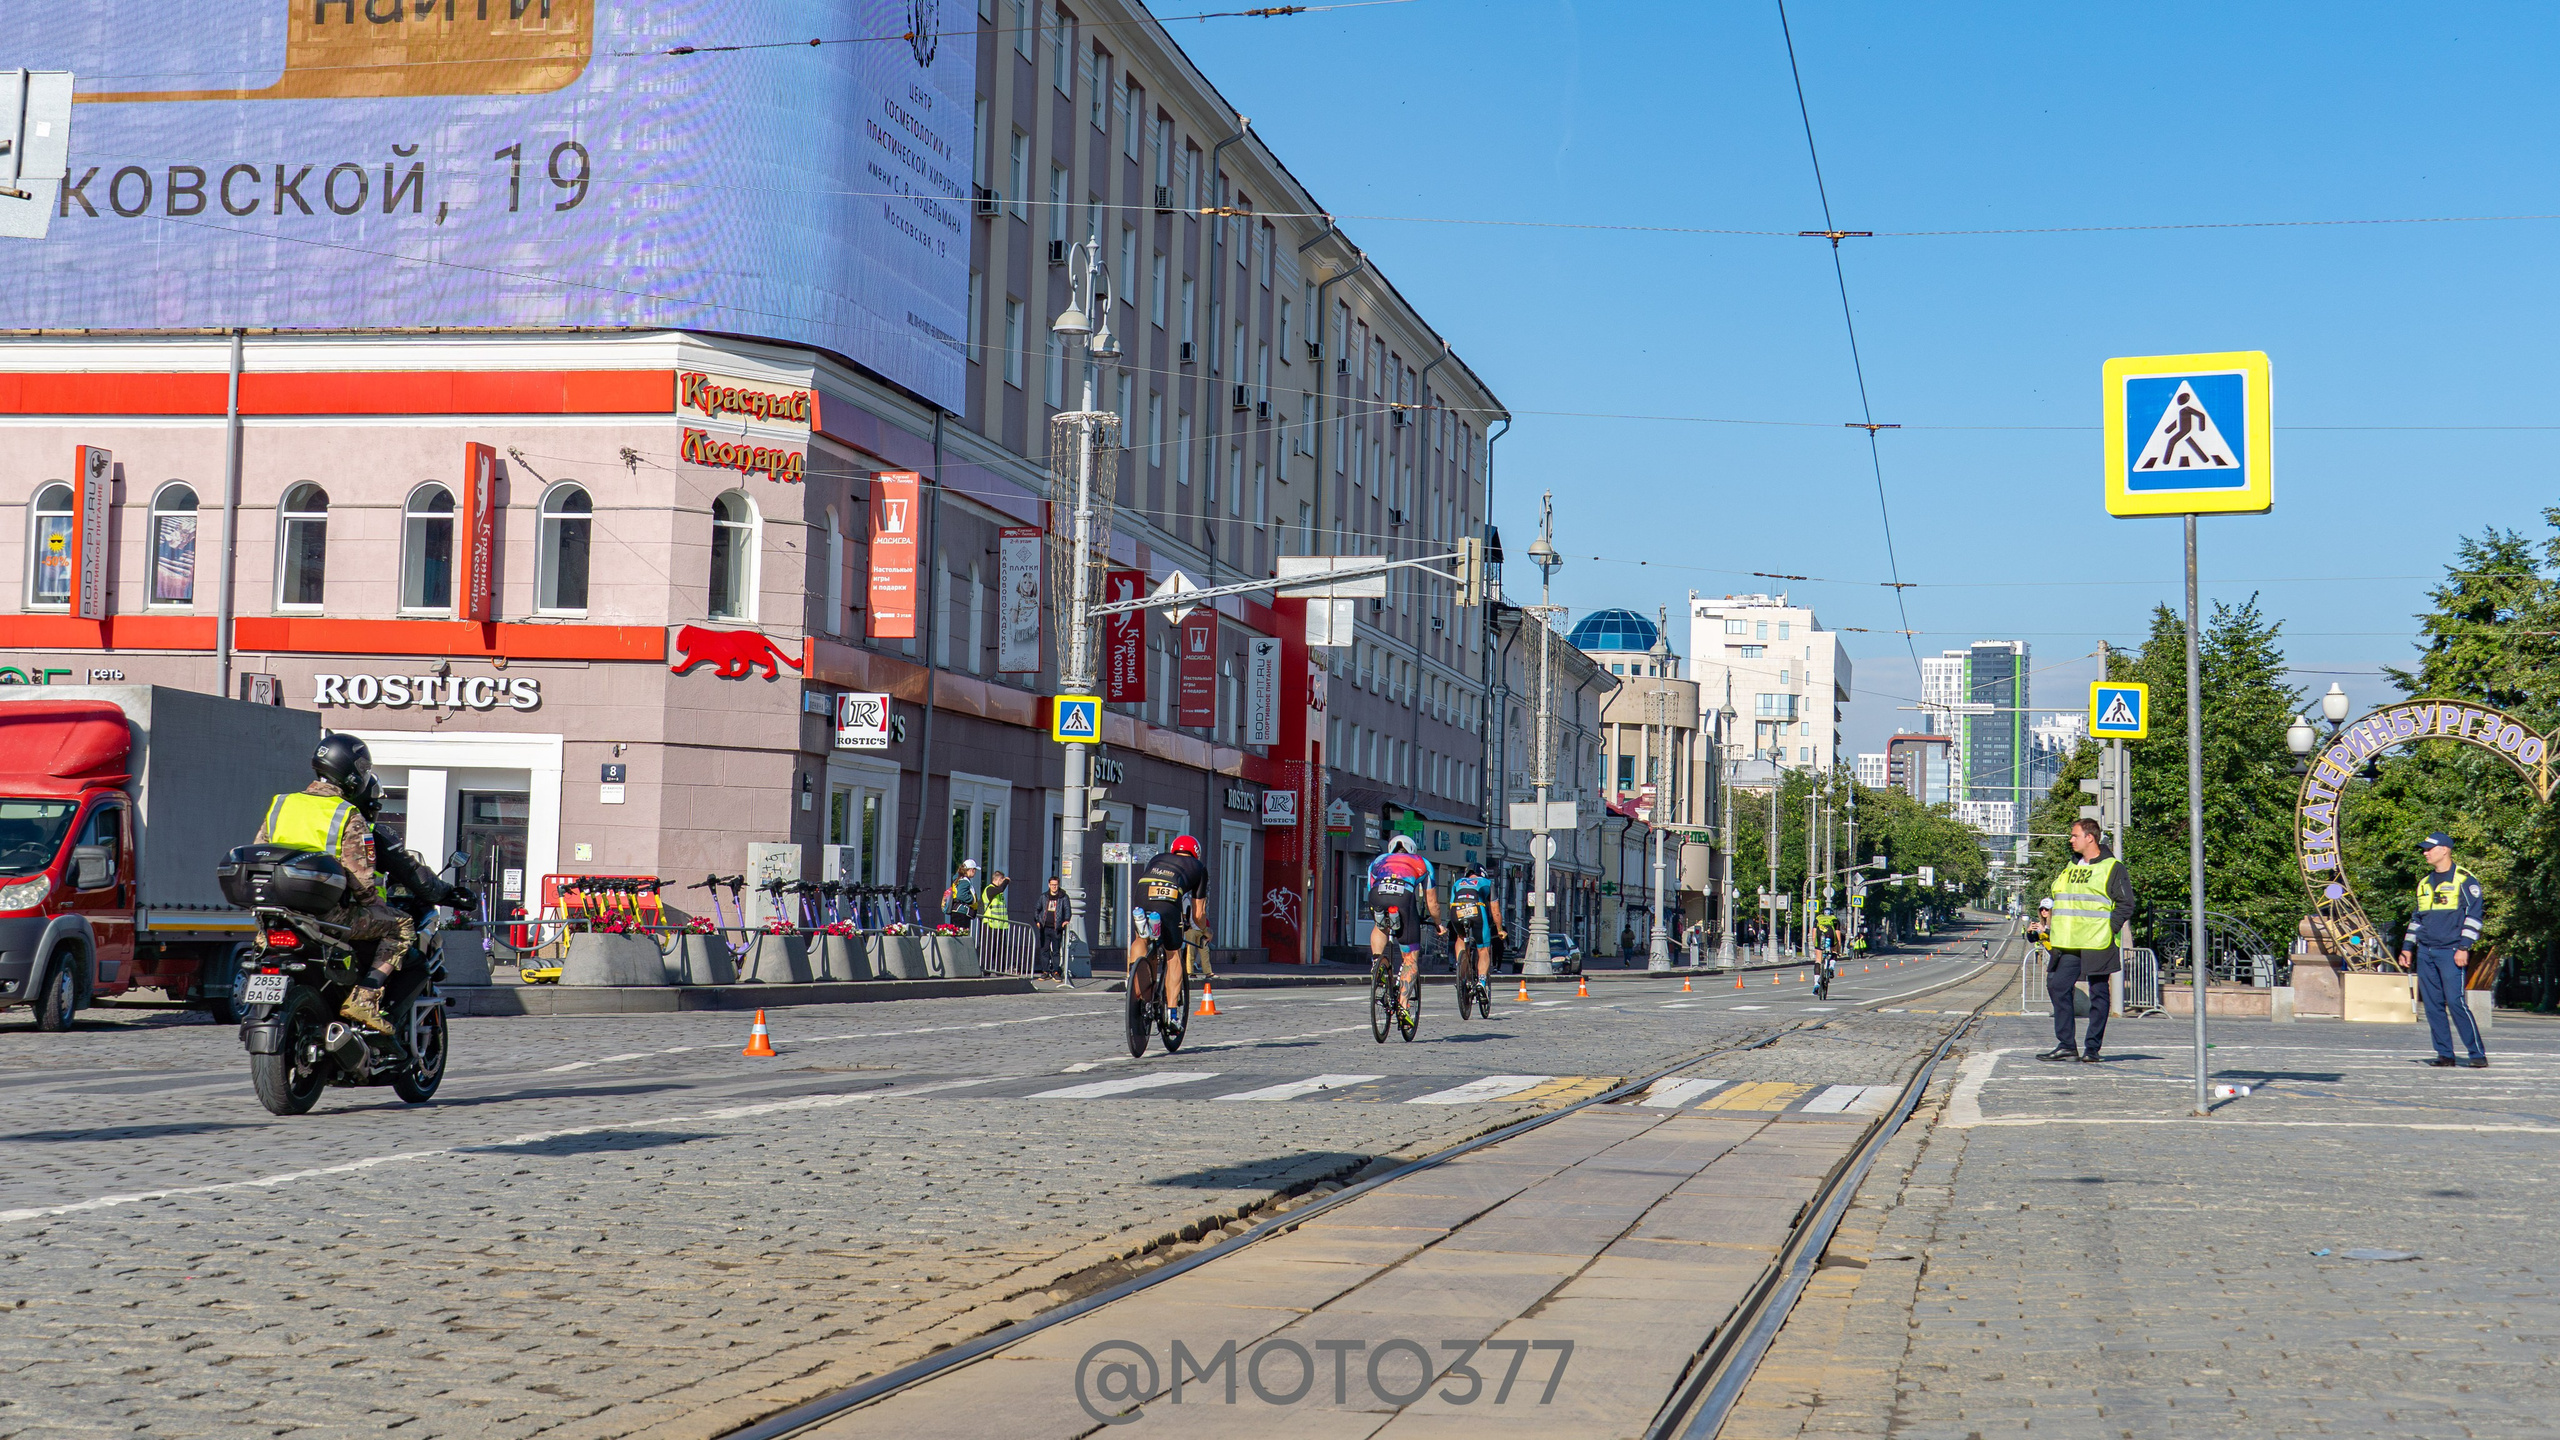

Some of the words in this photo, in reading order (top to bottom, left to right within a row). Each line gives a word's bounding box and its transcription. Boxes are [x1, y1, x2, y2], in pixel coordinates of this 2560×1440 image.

[909, 81, 932, 113] ЦЕНТР
[884, 96, 944, 157] КОСМЕТОЛОГИИ
[946, 144, 952, 163] И
[494, 140, 592, 213] 19
[866, 118, 927, 177] ПЛАСТИЧЕСКОЙ
[928, 165, 965, 206] ХИРУРГИИ
[867, 160, 892, 188] имени
[914, 188, 961, 237] НУДЕЛЬМАНА
[884, 201, 934, 254] Московская,
[937, 239, 946, 259] 19
[680, 372, 808, 422] Красный
[681, 427, 804, 483] Леопард
[84, 481, 98, 616] BODY-PIT.RU
[874, 537, 914, 545] МОСИГРА
[41, 555, 70, 568] -50%
[92, 539, 101, 616] СПОРТИВНОЕ
[471, 542, 483, 613] Леопард
[480, 523, 491, 596] Красный
[873, 565, 914, 573] Настольные
[1009, 564, 1039, 572] ПЛАТКИ
[878, 584, 908, 592] подарки
[92, 668, 124, 680] сеть
[1111, 644, 1127, 698] Леопард
[1124, 628, 1140, 684] Красный
[313, 673, 540, 709] ROSTIC'S
[1255, 658, 1266, 740] BODY-PIT.RU
[836, 737, 886, 746] ROSTIC'S
[610, 765, 617, 777] 8
[1227, 788, 1255, 813] ROSTIC'S
[1156, 887, 1171, 896] 163
[1384, 883, 1398, 892] 164
[254, 976, 282, 987] 2853
[267, 991, 281, 1001] 66
